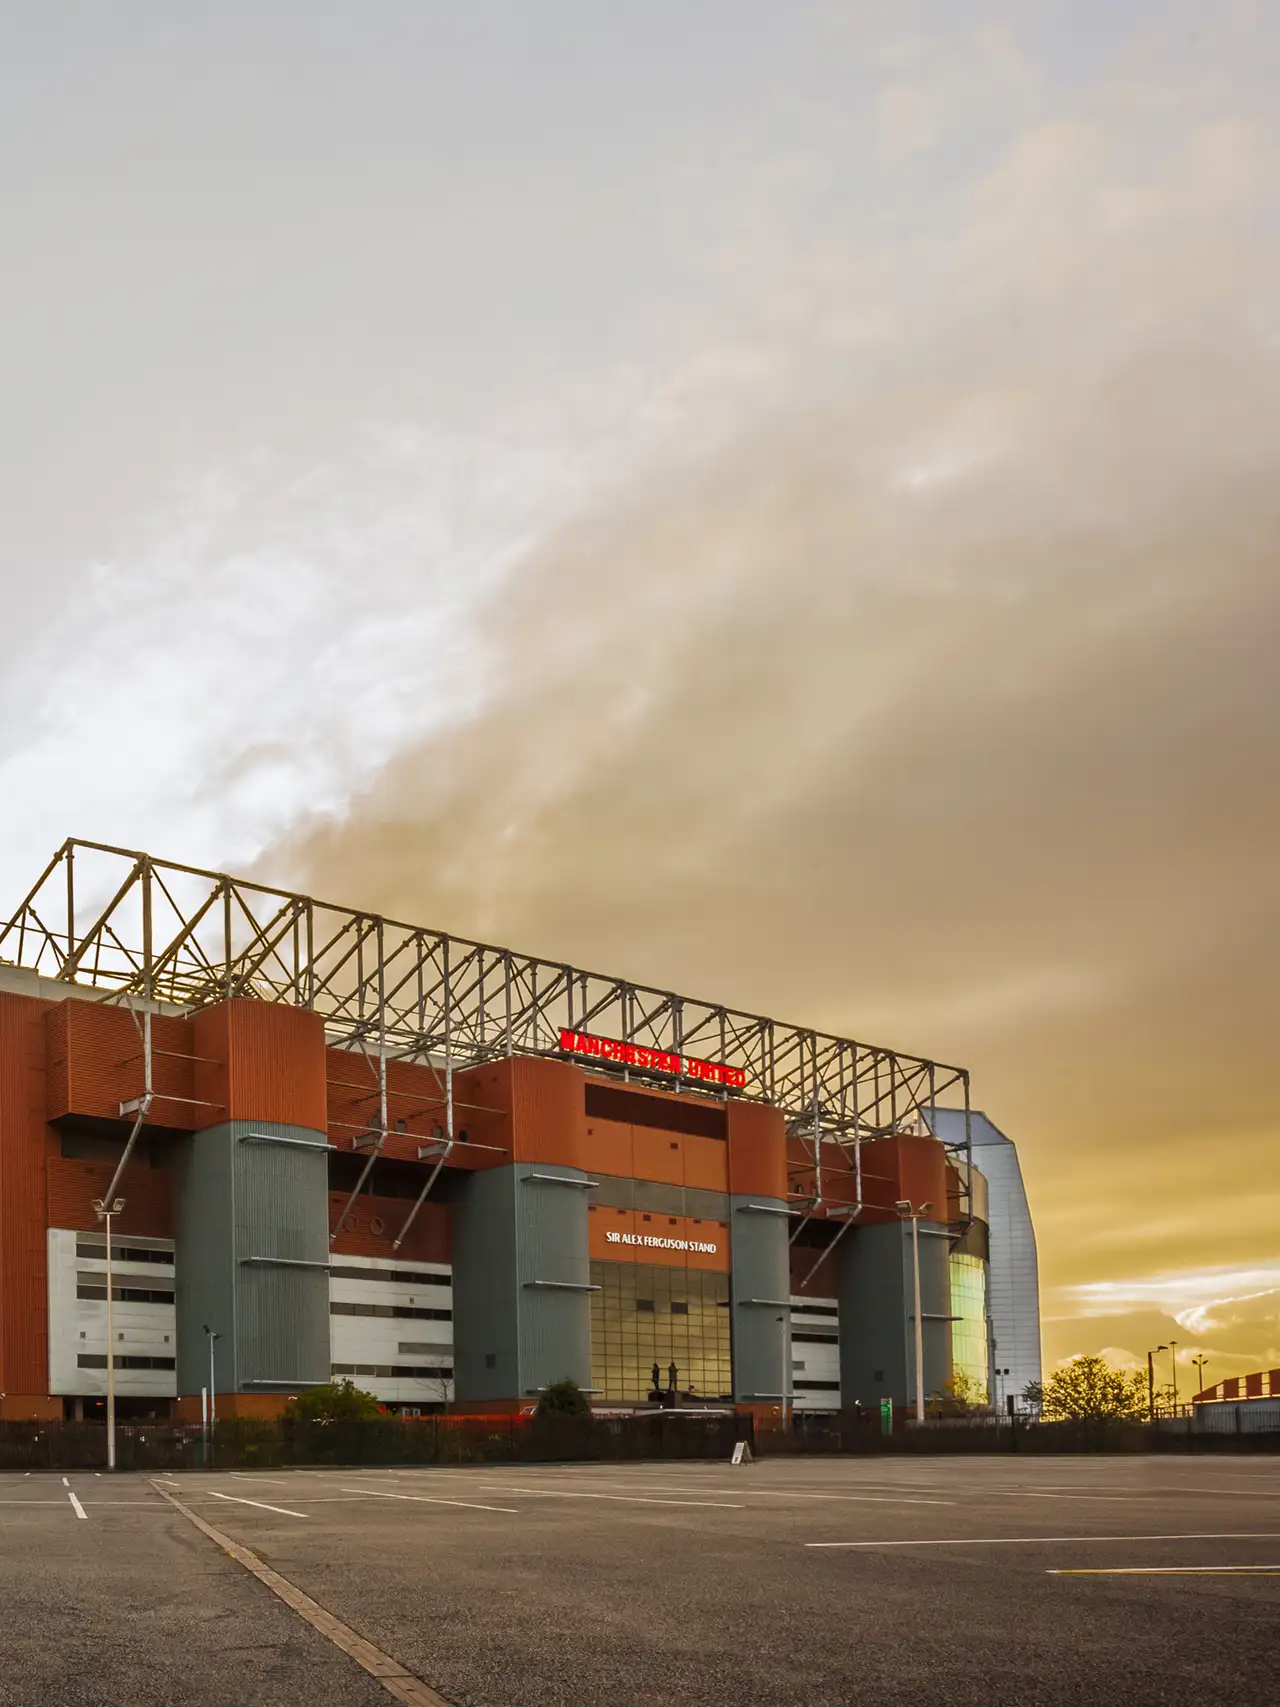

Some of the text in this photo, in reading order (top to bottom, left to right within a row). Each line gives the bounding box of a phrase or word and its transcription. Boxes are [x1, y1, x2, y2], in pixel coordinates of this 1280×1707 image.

[560, 1030, 746, 1088] MANCHESTER UNITED
[606, 1231, 716, 1254] SIR ALEX FERGUSON STAND
